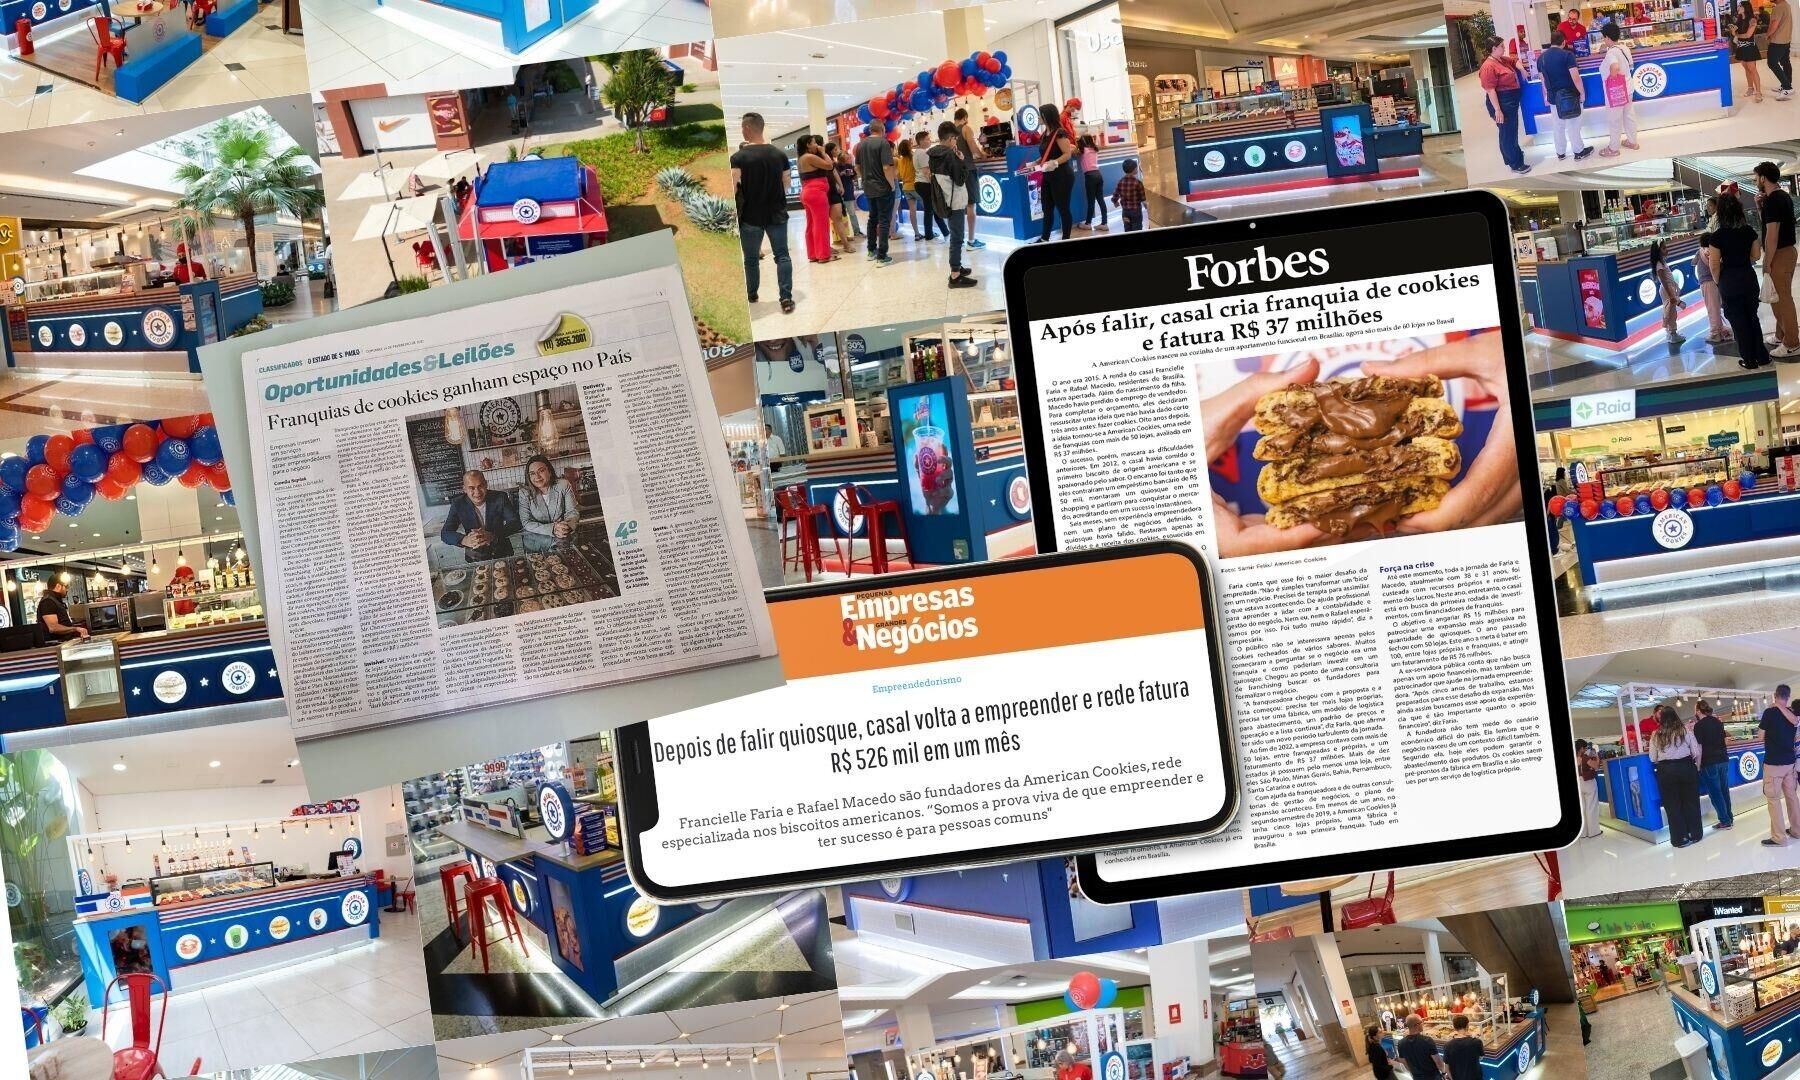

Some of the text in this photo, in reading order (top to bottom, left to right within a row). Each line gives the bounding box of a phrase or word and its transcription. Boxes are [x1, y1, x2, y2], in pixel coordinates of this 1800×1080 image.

[1636, 66, 1663, 80] AMERICAN
[1639, 83, 1663, 94] COOKIES
[1183, 244, 1329, 291] Forbes
[1040, 272, 1479, 343] Após falir, casal cria franquia de cookies
[144, 309, 172, 328] AMERICAN
[148, 331, 172, 344] COOKIES
[1142, 308, 1383, 351] e fatura R$ 37 milhões
[258, 359, 303, 373] CLASSIFICADOS
[268, 348, 632, 430] Franquias de cookies ganham espaço no País
[484, 400, 517, 419] AMERICAN
[1595, 400, 1632, 419] Raia
[487, 418, 516, 434] COOKIES
[1618, 435, 1633, 443] Raia
[1658, 512, 1688, 529] AMERICAN
[616, 538, 638, 547] LUGAR
[1661, 531, 1688, 545] COOKIES
[1379, 565, 1402, 574] Força
[1414, 560, 1435, 569] crise
[856, 590, 893, 600] PEQUENAS
[839, 586, 975, 622] Empresas
[875, 619, 907, 628] GRANDES
[855, 613, 979, 655] Negócios
[225, 663, 252, 676] AMERICAN
[229, 680, 251, 691] COOKIES
[871, 676, 962, 694] Empreendedorismo
[655, 679, 1189, 765] Depois de falir quiosque, casal volta a empreender e rede fatura
[830, 730, 1020, 774] R$ 526 mil em um mês
[678, 756, 1182, 829] Francielle Faria e Rafael Macedo são fundadores da American Cookies, rede
[541, 791, 562, 813] AMERICAN
[661, 827, 750, 850] especializada
[752, 826, 777, 838] nos
[779, 818, 839, 834] biscoitos
[842, 809, 924, 827] americanos.
[981, 800, 989, 809] a
[991, 795, 1030, 811] prova
[1032, 790, 1060, 803] viva
[1062, 786, 1078, 799] de
[1081, 785, 1106, 799] que
[1109, 773, 1193, 794] empreender
[1196, 773, 1204, 782] e
[546, 817, 564, 833] COOKIES
[817, 836, 837, 847] ter
[840, 830, 892, 845] sucesso
[895, 826, 903, 838] é
[905, 824, 936, 839] para
[938, 818, 991, 835] pessoas
[345, 893, 366, 907] AMERICAN
[347, 910, 366, 921] COOKIES
[1713, 905, 1743, 916] iWanted
